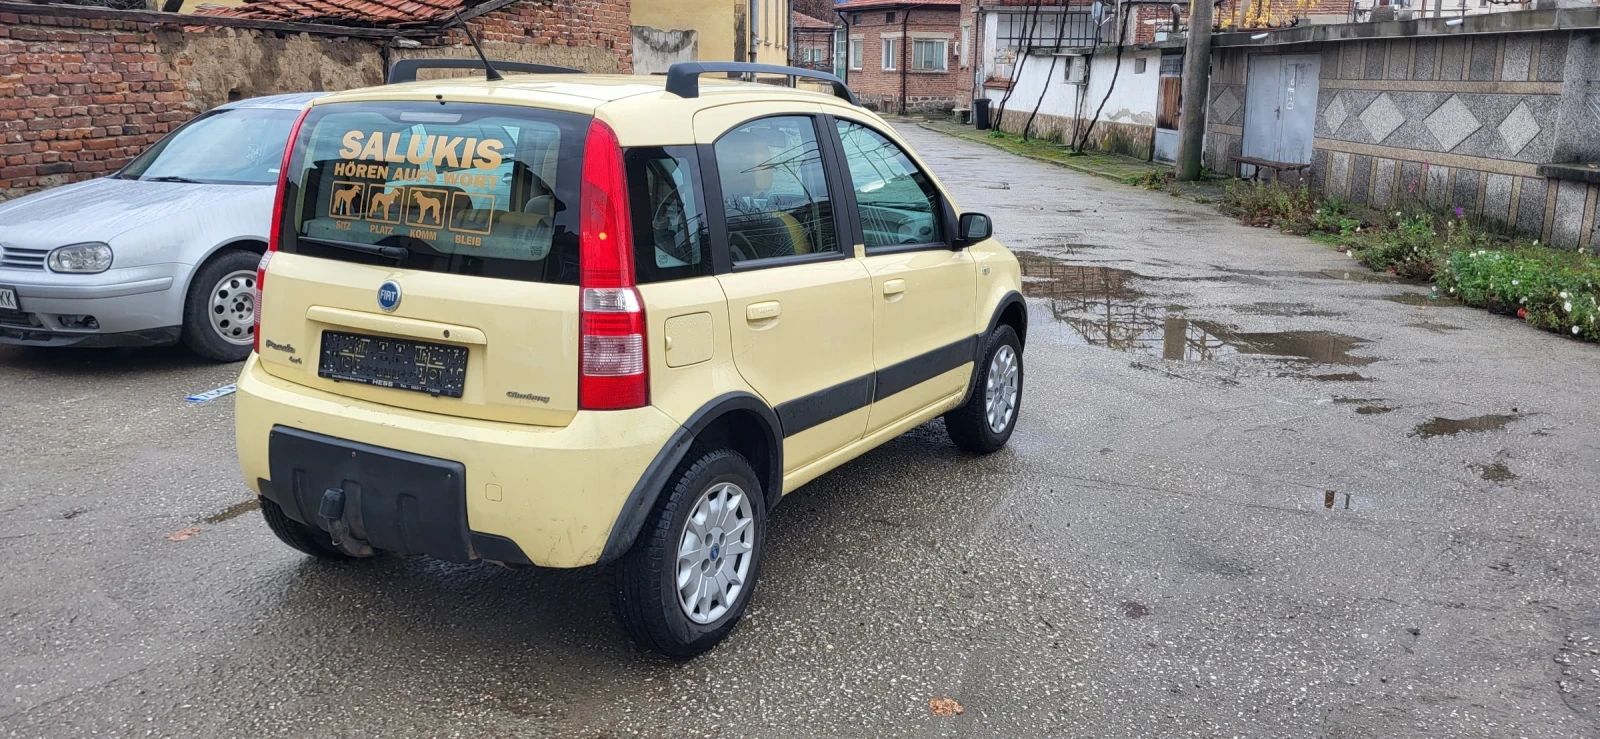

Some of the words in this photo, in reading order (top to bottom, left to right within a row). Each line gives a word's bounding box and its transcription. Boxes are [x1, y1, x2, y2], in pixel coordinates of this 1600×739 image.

[339, 130, 504, 171] SALUKIS
[334, 161, 389, 180] HÖREN
[392, 167, 438, 184] AUFS
[443, 172, 498, 190] WORT
[336, 221, 352, 230] SITZ
[370, 224, 394, 235] PLATZ
[409, 229, 437, 240] KOMM
[455, 234, 482, 246] BLEIB
[380, 289, 397, 302] FIAT
[372, 379, 394, 387] HESS
